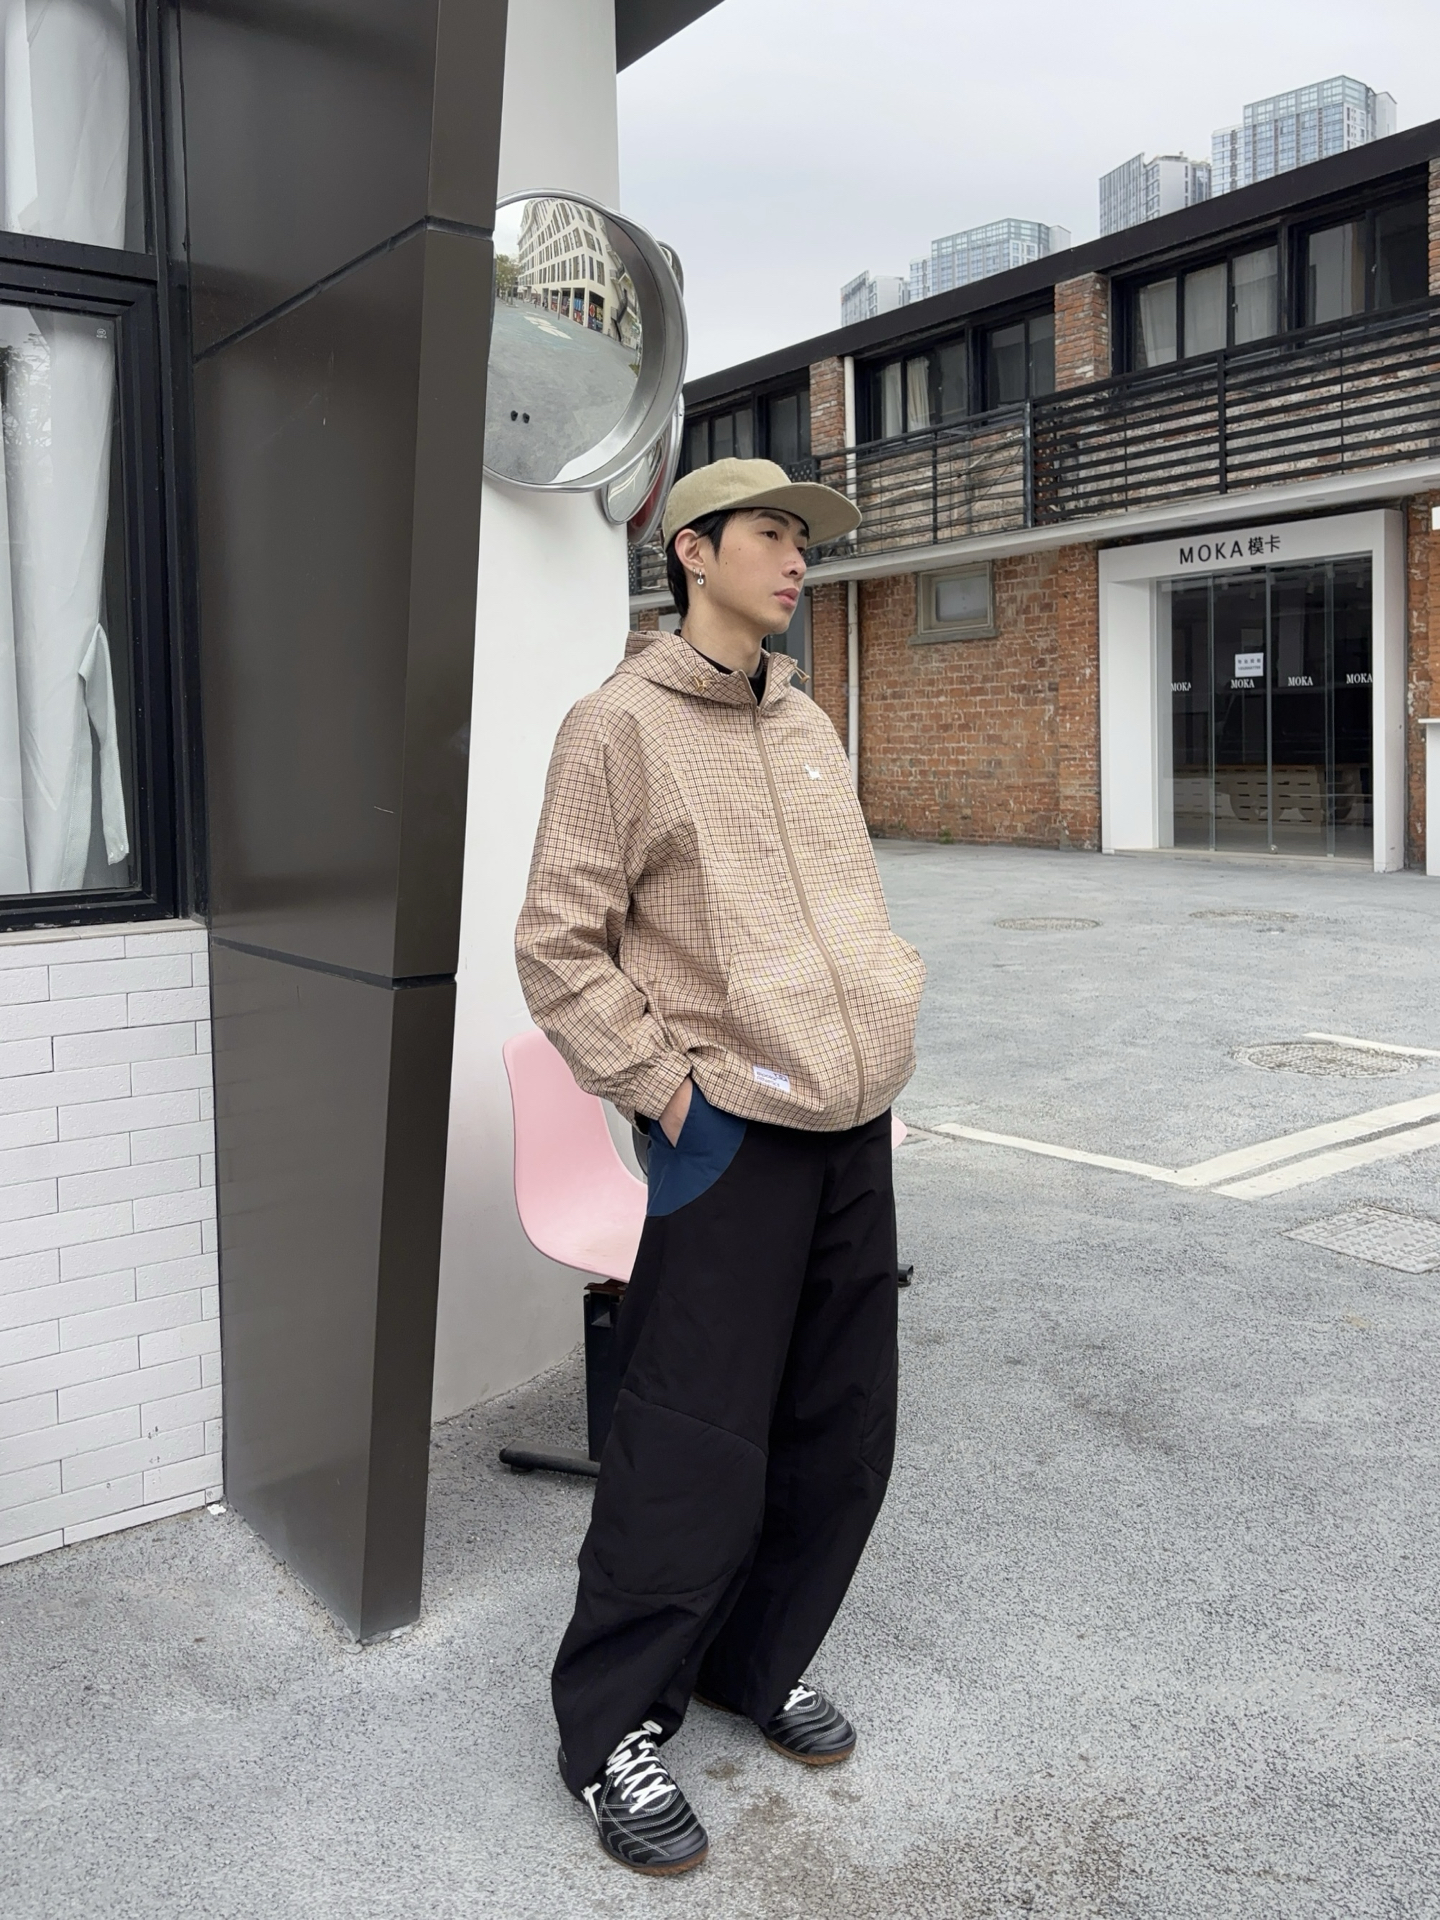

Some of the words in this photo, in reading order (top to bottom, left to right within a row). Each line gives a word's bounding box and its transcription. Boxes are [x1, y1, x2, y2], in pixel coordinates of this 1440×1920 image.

[1179, 540, 1243, 565] MOKA
[1248, 534, 1281, 556] 模卡
[1230, 678, 1255, 689] MOKA
[1287, 676, 1314, 687] MOKA
[1346, 673, 1373, 684] MOKA
